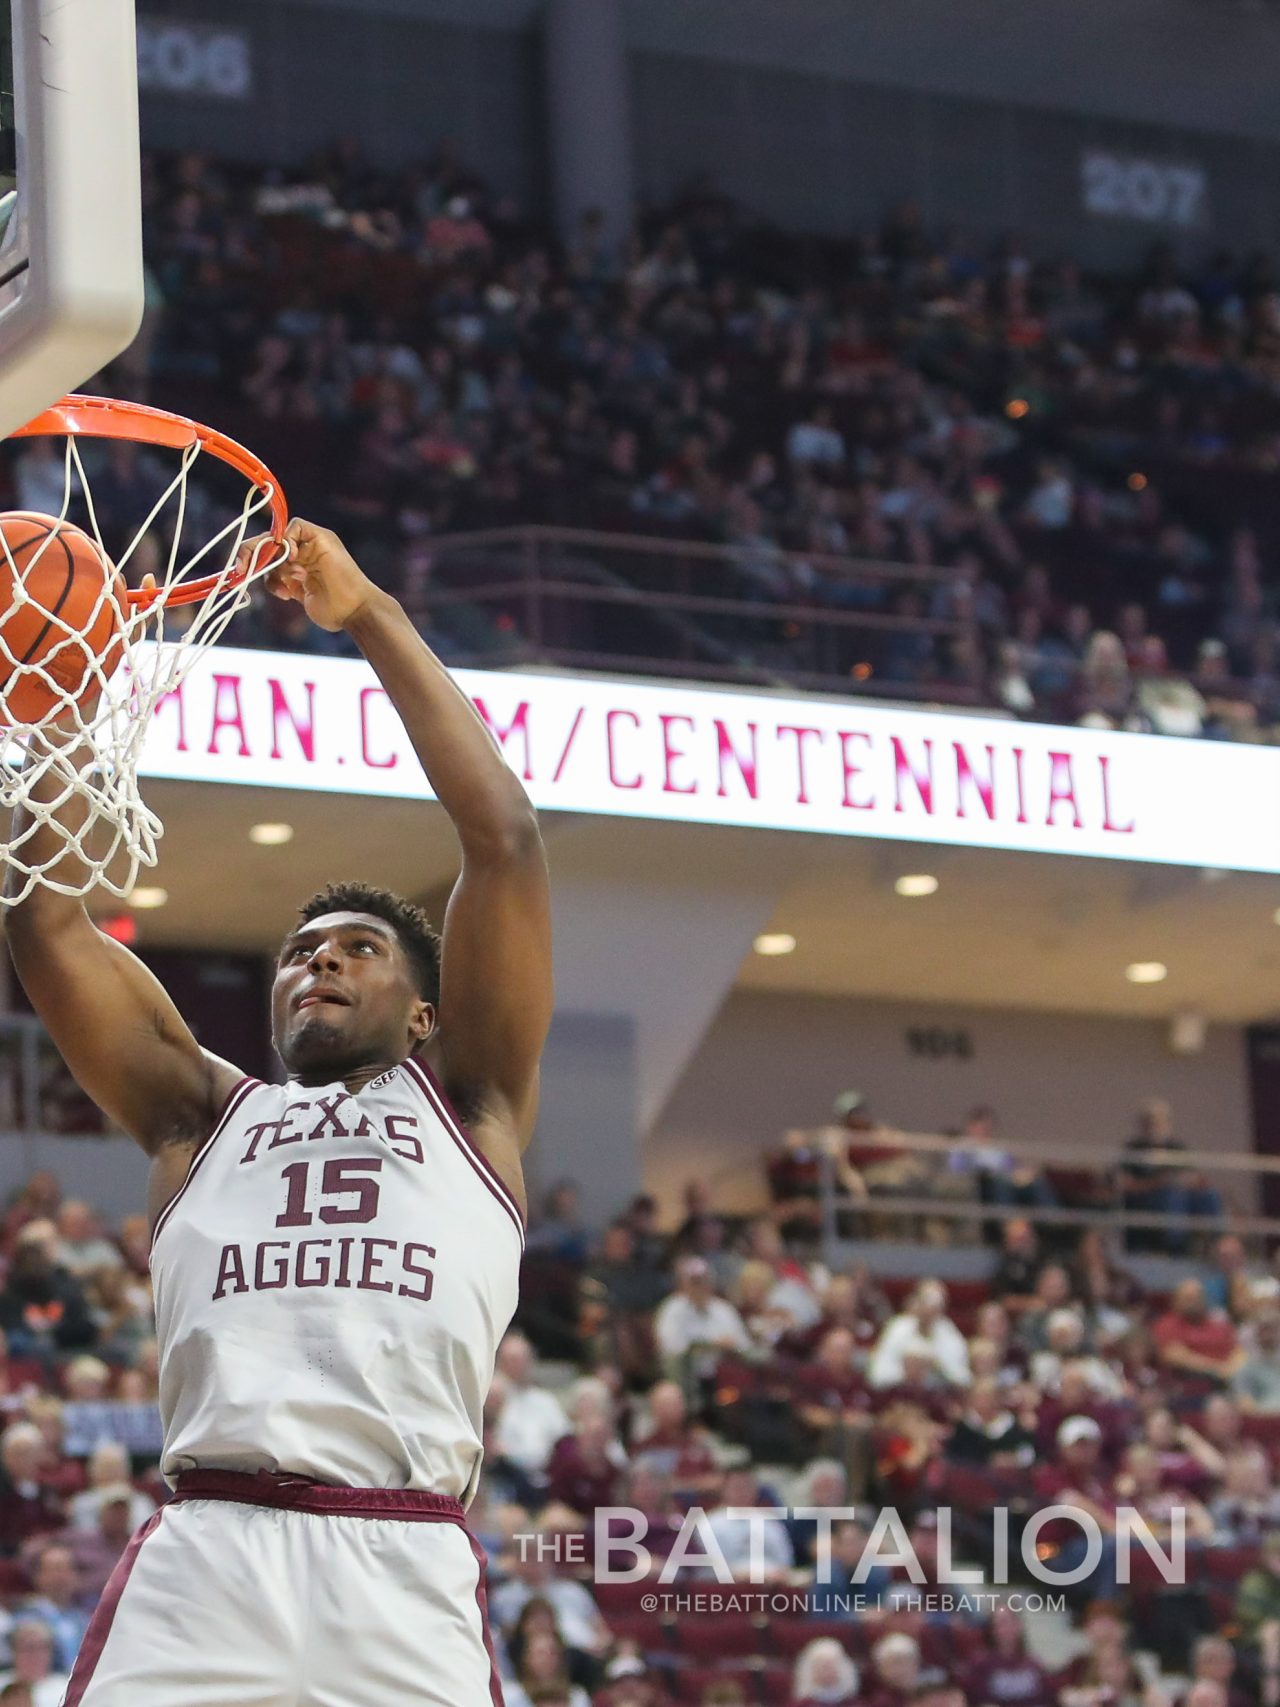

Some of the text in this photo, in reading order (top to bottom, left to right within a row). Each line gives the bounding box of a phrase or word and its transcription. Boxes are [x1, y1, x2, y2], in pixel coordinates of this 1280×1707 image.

[1080, 154, 1205, 225] 207
[374, 1071, 396, 1087] SEC
[239, 1092, 424, 1165] TEXAS
[275, 1158, 383, 1228] 15
[212, 1237, 436, 1302] AGGIES
